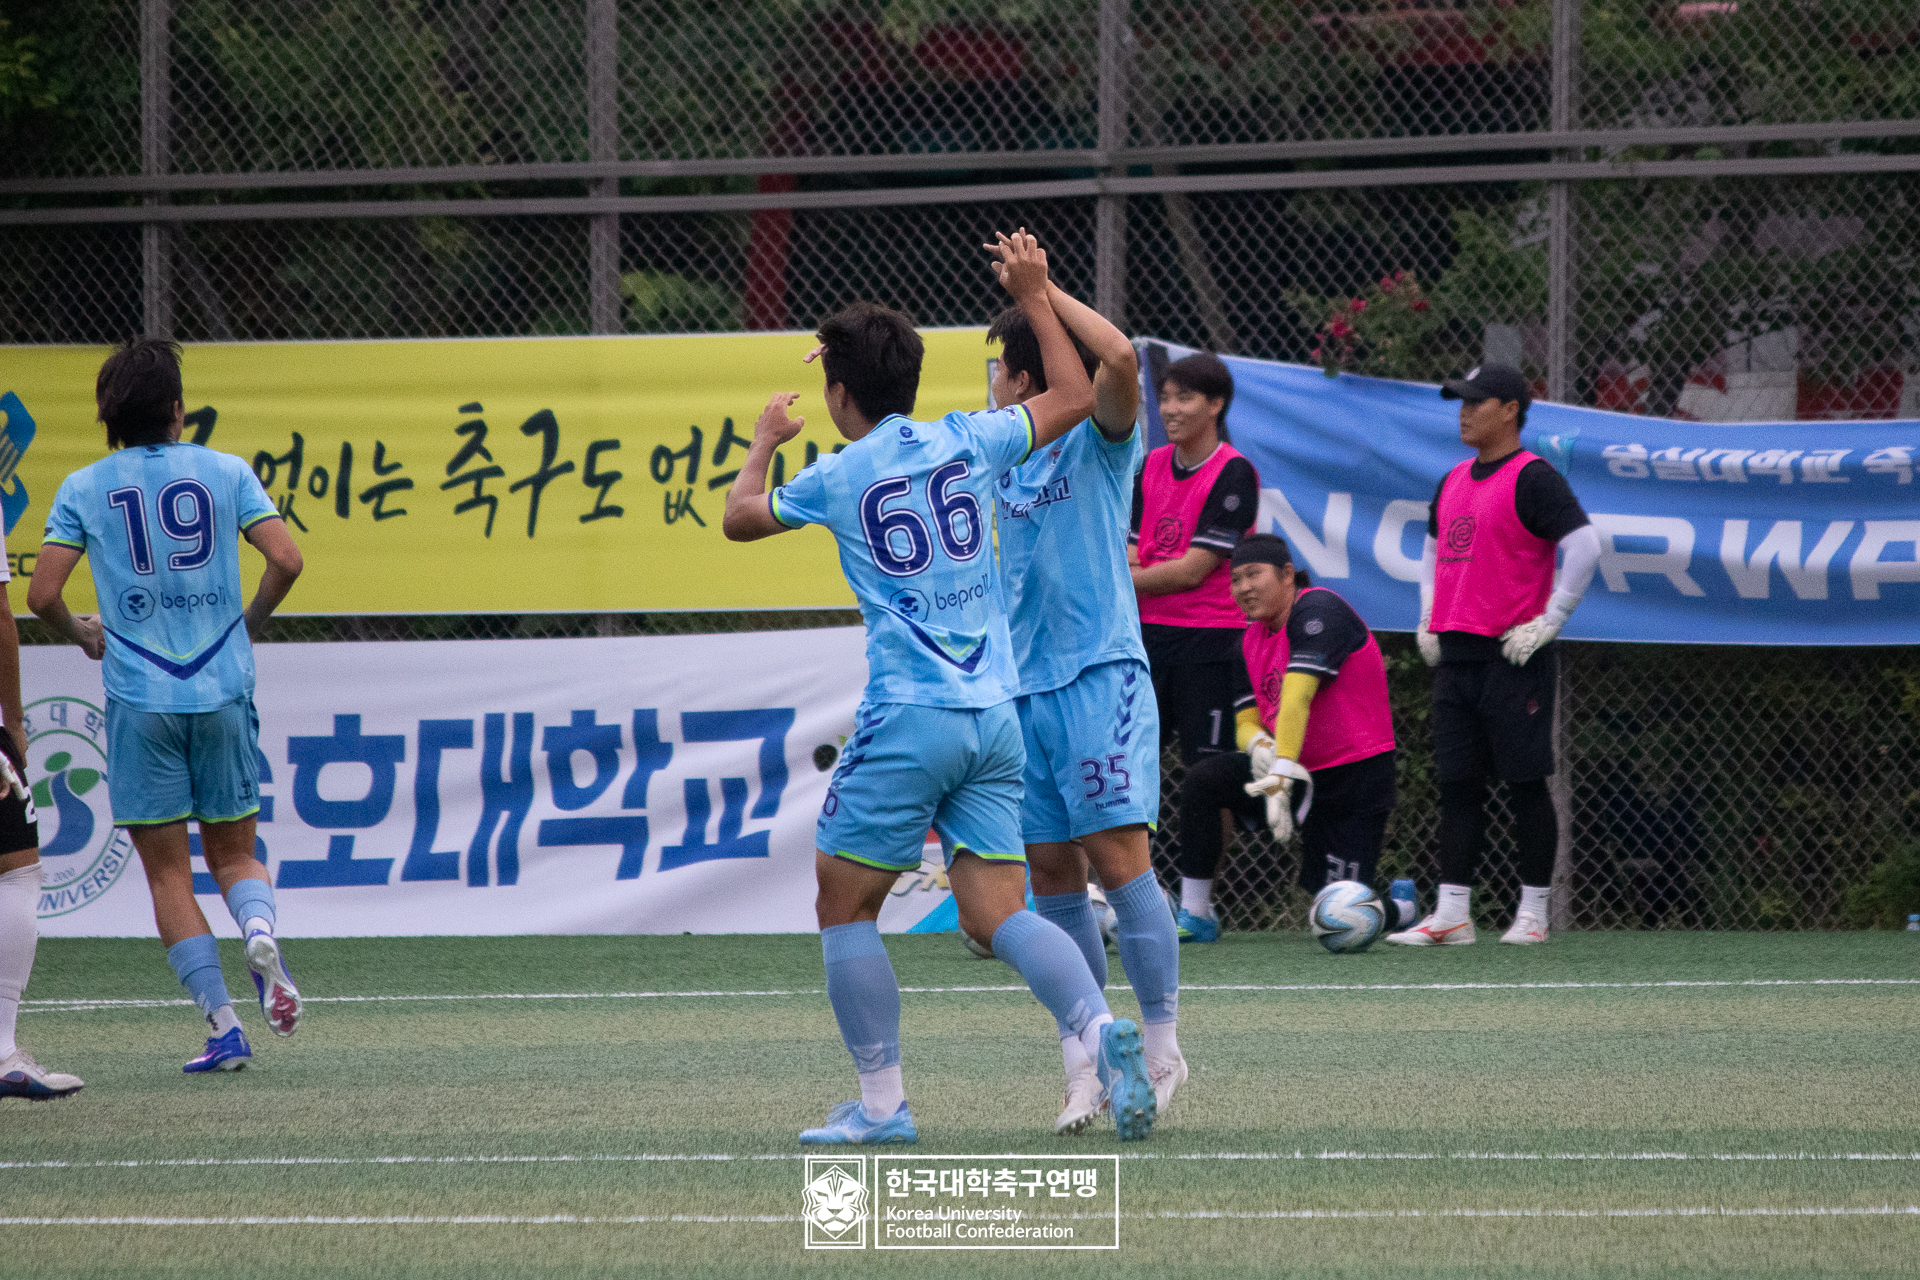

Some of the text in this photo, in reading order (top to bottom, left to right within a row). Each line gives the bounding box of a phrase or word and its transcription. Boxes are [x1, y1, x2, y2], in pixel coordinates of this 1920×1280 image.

[440, 402, 624, 538] 축구도
[1862, 446, 1920, 484] 축
[107, 478, 216, 575] 19
[858, 458, 984, 578] 66
[1210, 709, 1222, 745] 1
[187, 707, 796, 895] 호대학교
[1079, 752, 1132, 801] 35
